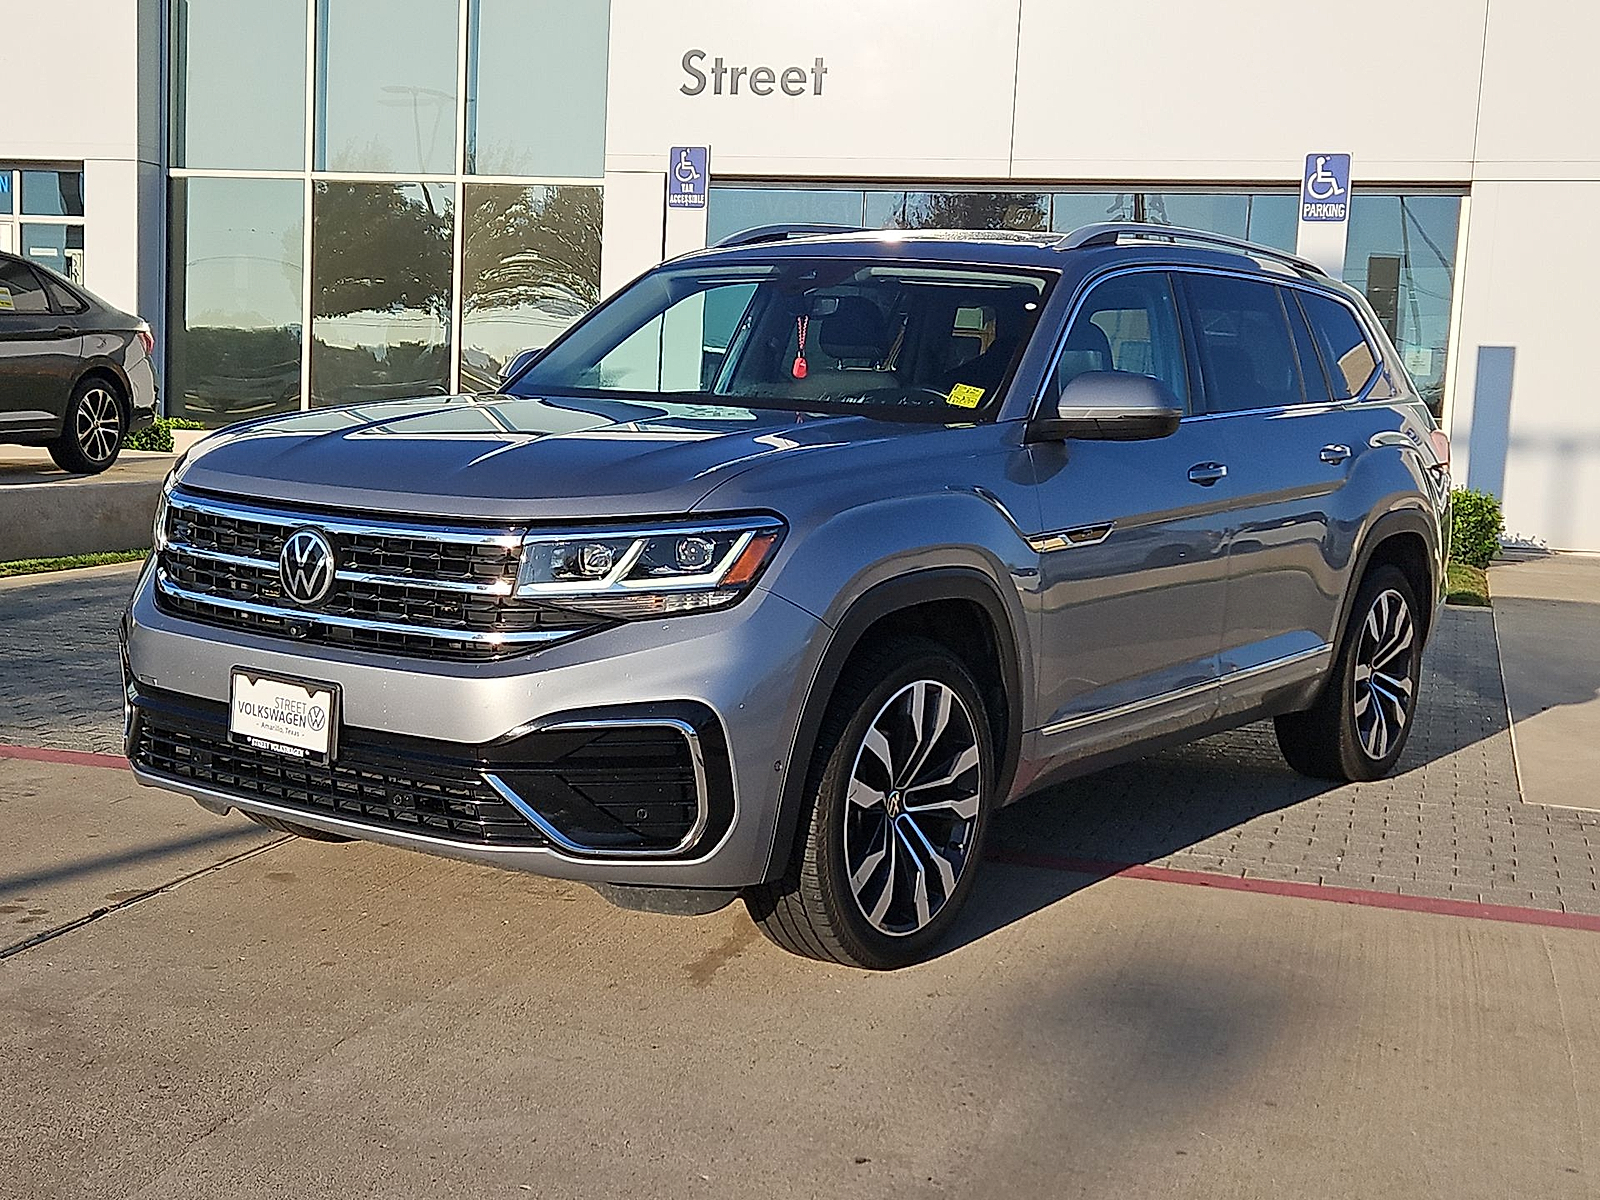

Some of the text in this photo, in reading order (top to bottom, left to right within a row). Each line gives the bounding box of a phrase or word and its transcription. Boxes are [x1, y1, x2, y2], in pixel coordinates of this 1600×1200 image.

[679, 49, 828, 96] Street
[1303, 203, 1346, 218] PARKING
[238, 700, 307, 729] VOLKSWAGEN
[274, 696, 307, 715] STREET
